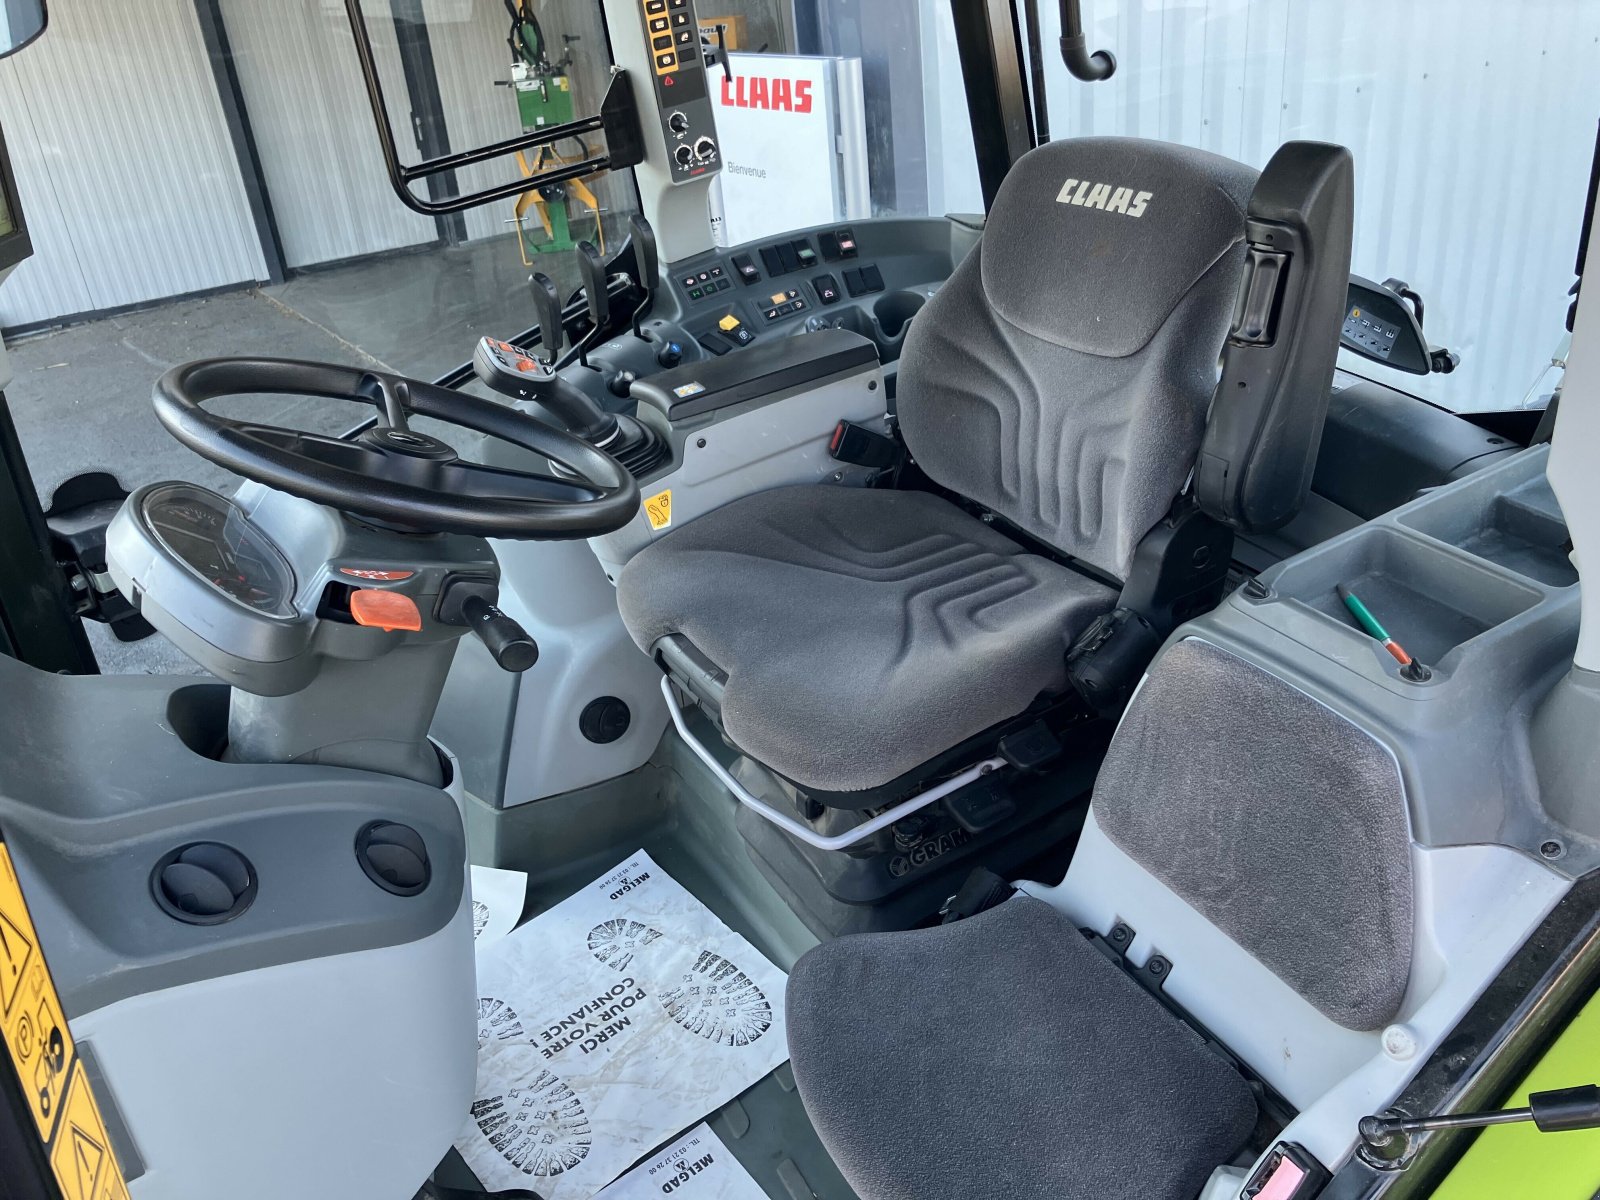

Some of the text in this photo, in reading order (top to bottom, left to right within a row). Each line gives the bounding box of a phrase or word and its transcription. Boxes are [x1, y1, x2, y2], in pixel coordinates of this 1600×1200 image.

[721, 75, 812, 114] CLAAS
[727, 161, 767, 179] Bienvenue
[1055, 178, 1153, 218] CLAAS
[609, 872, 651, 900] MELGAD
[540, 977, 635, 1042] CONFIANCE
[540, 987, 647, 1060] POUR VOTRE
[579, 1016, 632, 1054] MERCI
[656, 1162, 665, 1170] 26
[664, 1157, 672, 1165] 37
[671, 1152, 680, 1160] 21
[678, 1146, 687, 1155] 03
[661, 1153, 715, 1194] MELGAD
